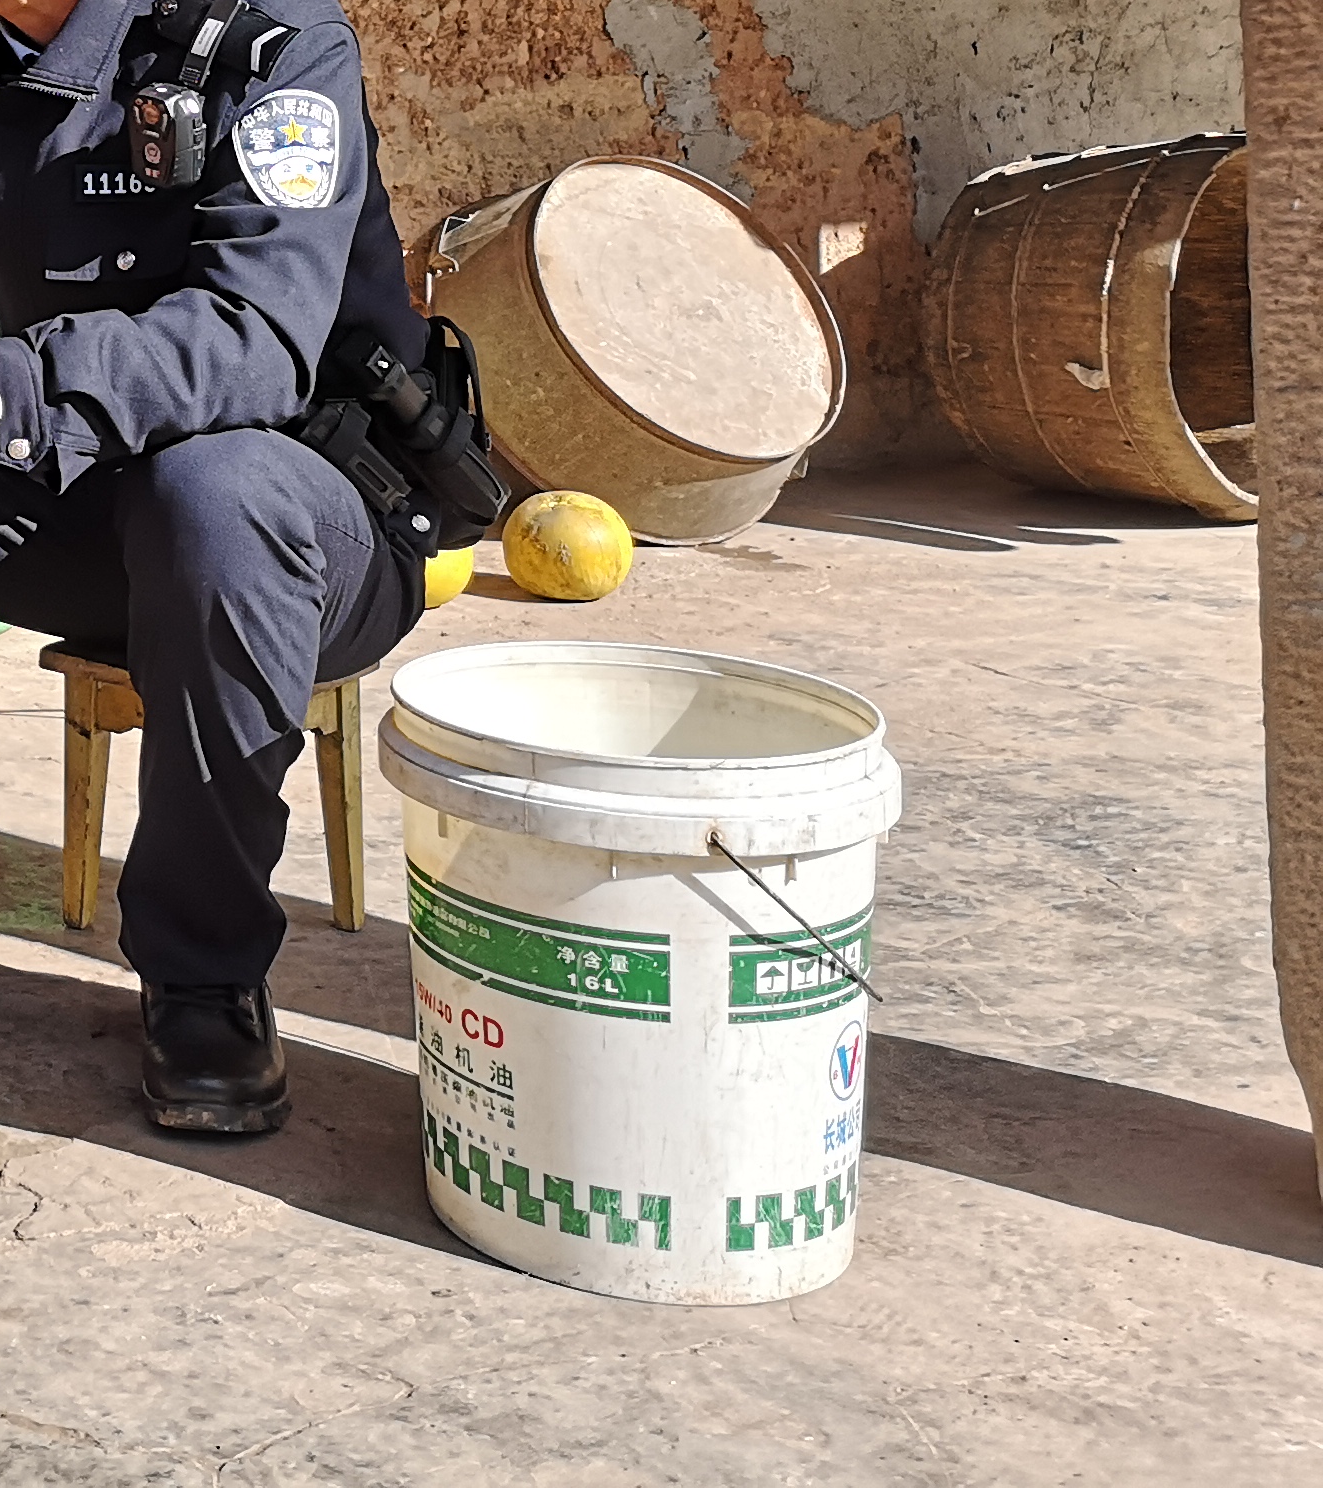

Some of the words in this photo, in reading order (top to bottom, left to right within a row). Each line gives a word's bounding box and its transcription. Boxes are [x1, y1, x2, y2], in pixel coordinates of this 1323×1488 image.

[240, 98, 334, 129] 中华人民共和国
[556, 946, 630, 975] 净含量
[567, 971, 620, 994] 16L
[461, 1008, 504, 1048] CD
